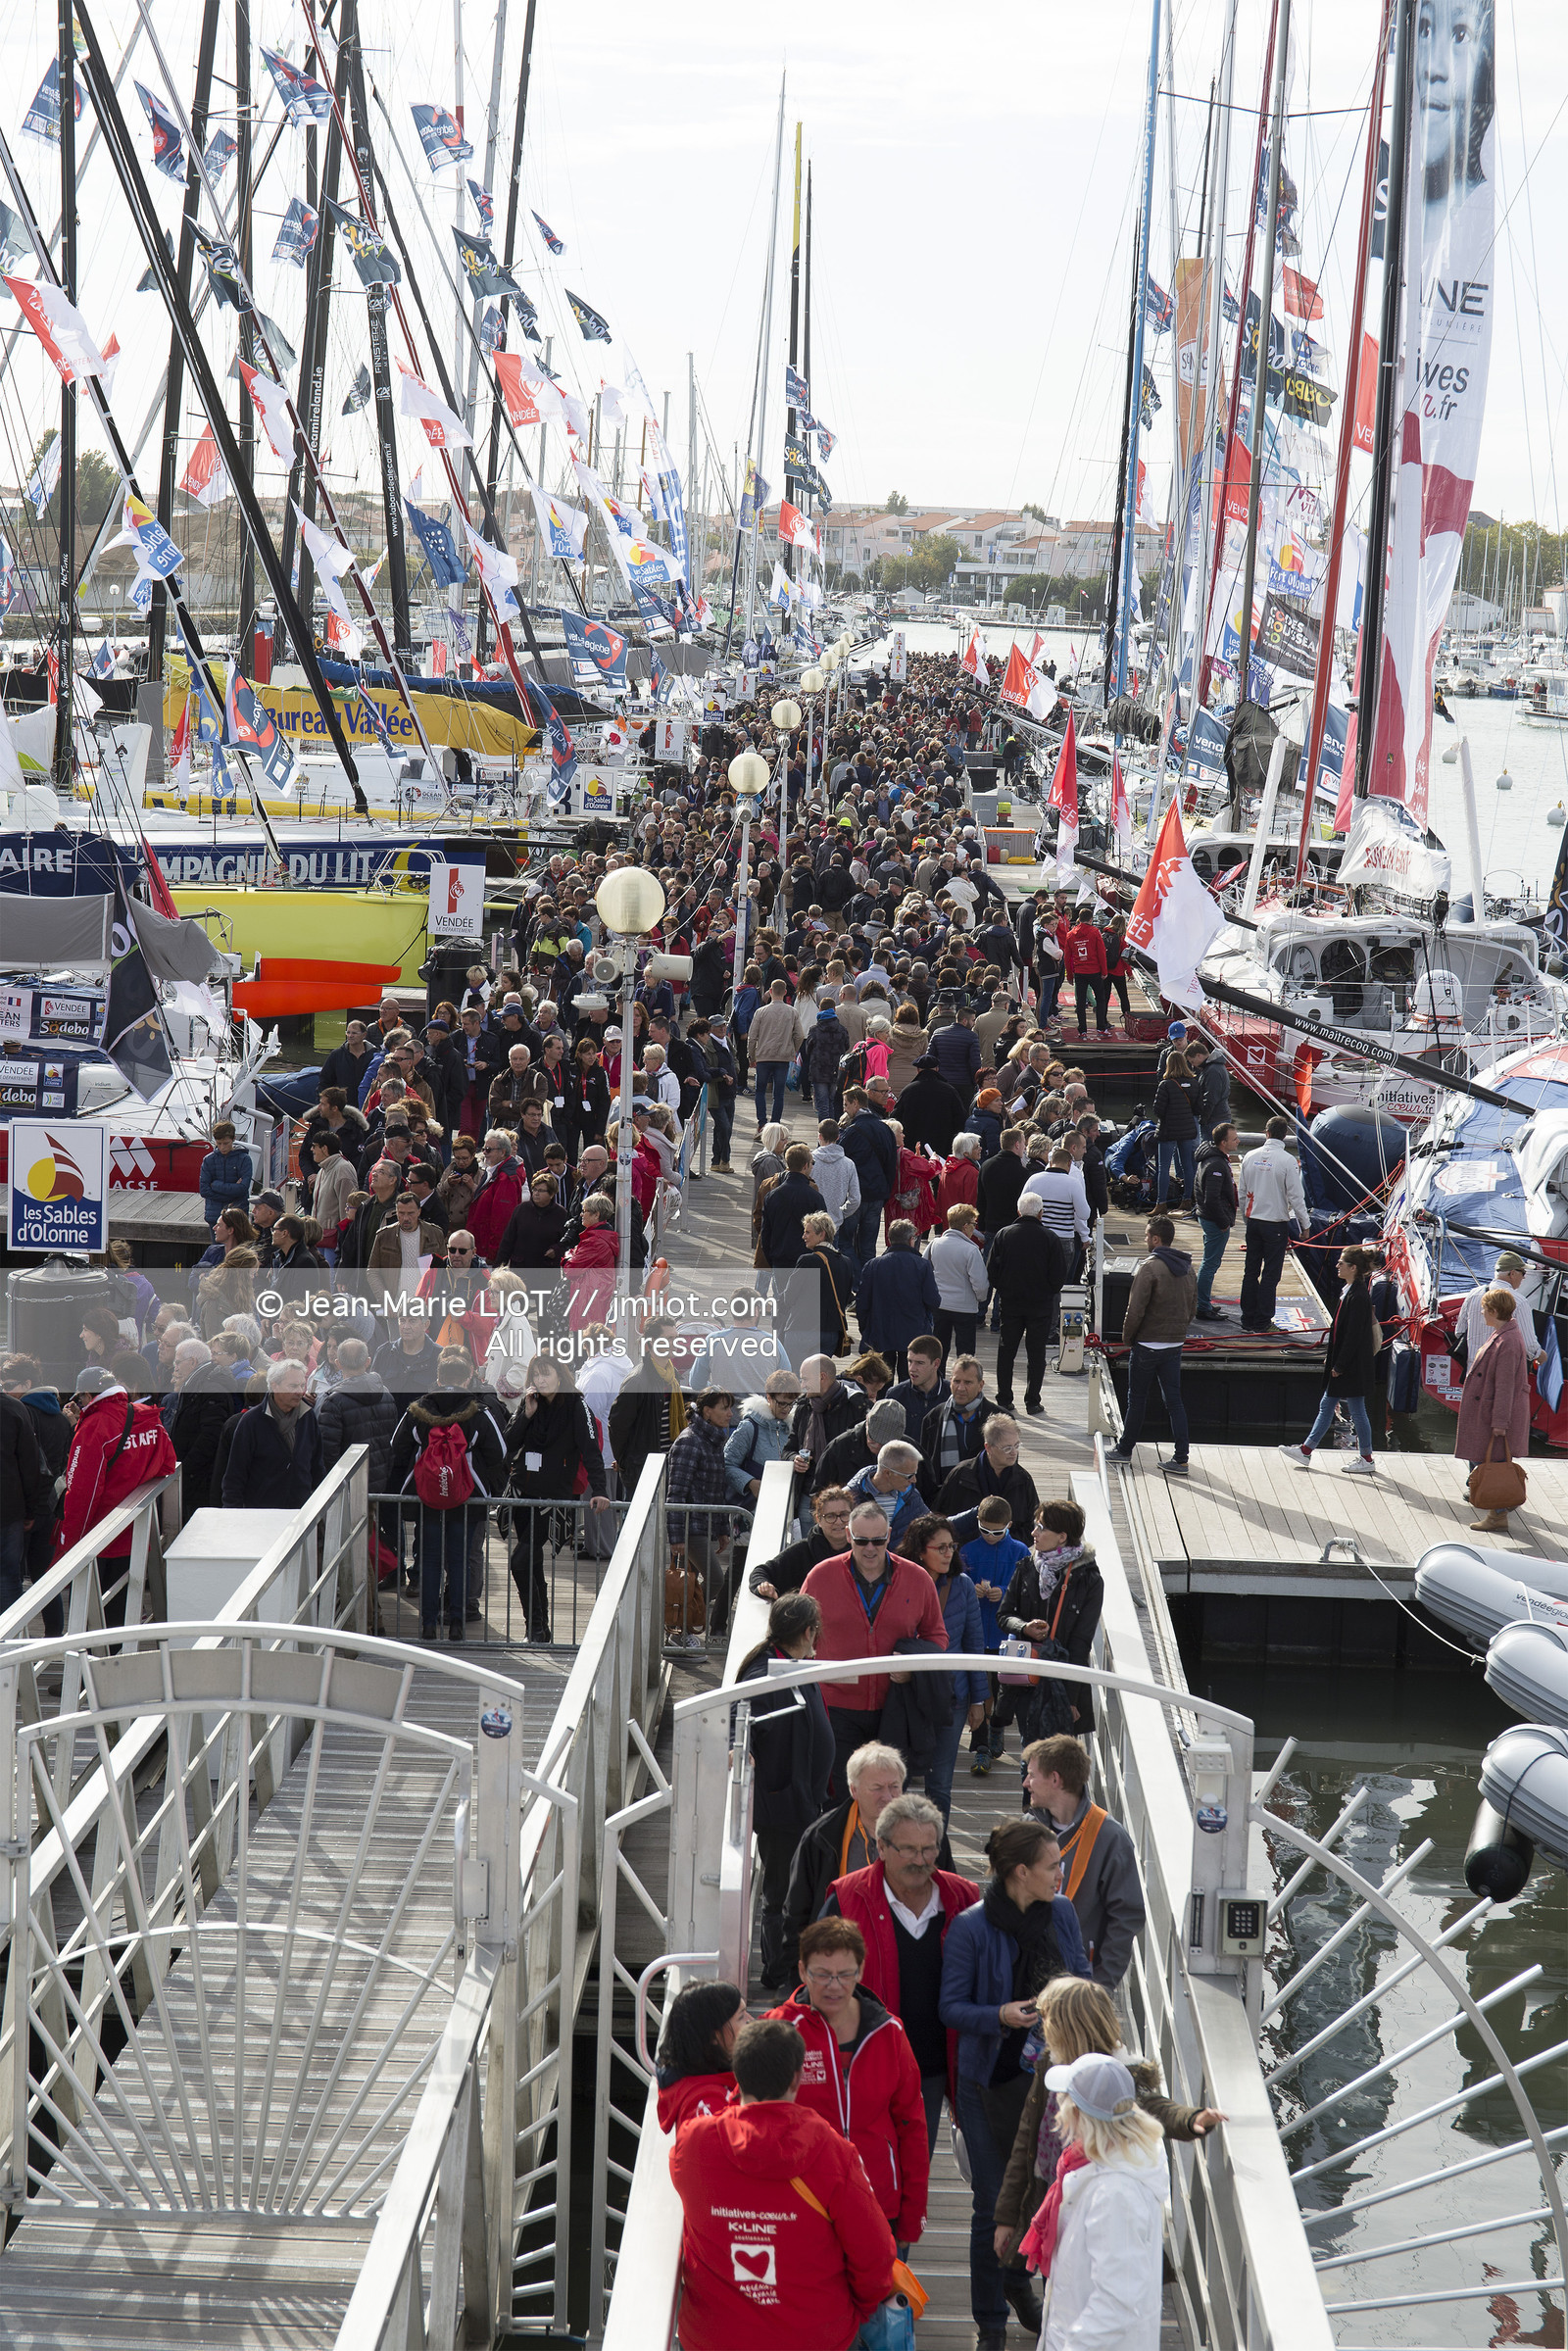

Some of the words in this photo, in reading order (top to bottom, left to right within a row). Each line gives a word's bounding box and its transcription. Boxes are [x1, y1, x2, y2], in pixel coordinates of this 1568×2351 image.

[1270, 606, 1305, 633] CODES
[1268, 619, 1320, 653] ROUSSEA
[593, 796, 612, 806] Sables
[290, 853, 327, 883] DU
[330, 852, 374, 882] LIT
[435, 914, 473, 928] VENDÉE
[54, 1002, 87, 1013] VENDÉE
[39, 1020, 90, 1035] Sodebo
[1294, 1016, 1393, 1061] www.maitrecoq.com
[2, 1088, 36, 1102] debo
[1377, 1090, 1436, 1104] nitiatives
[113, 1180, 159, 1191] ACSF
[24, 1204, 41, 1221] les
[44, 1205, 97, 1225] Sables
[18, 1223, 89, 1245] d'Olonne
[122, 1429, 158, 1450] STAFF
[1515, 1592, 1568, 1618] vendéeglo
